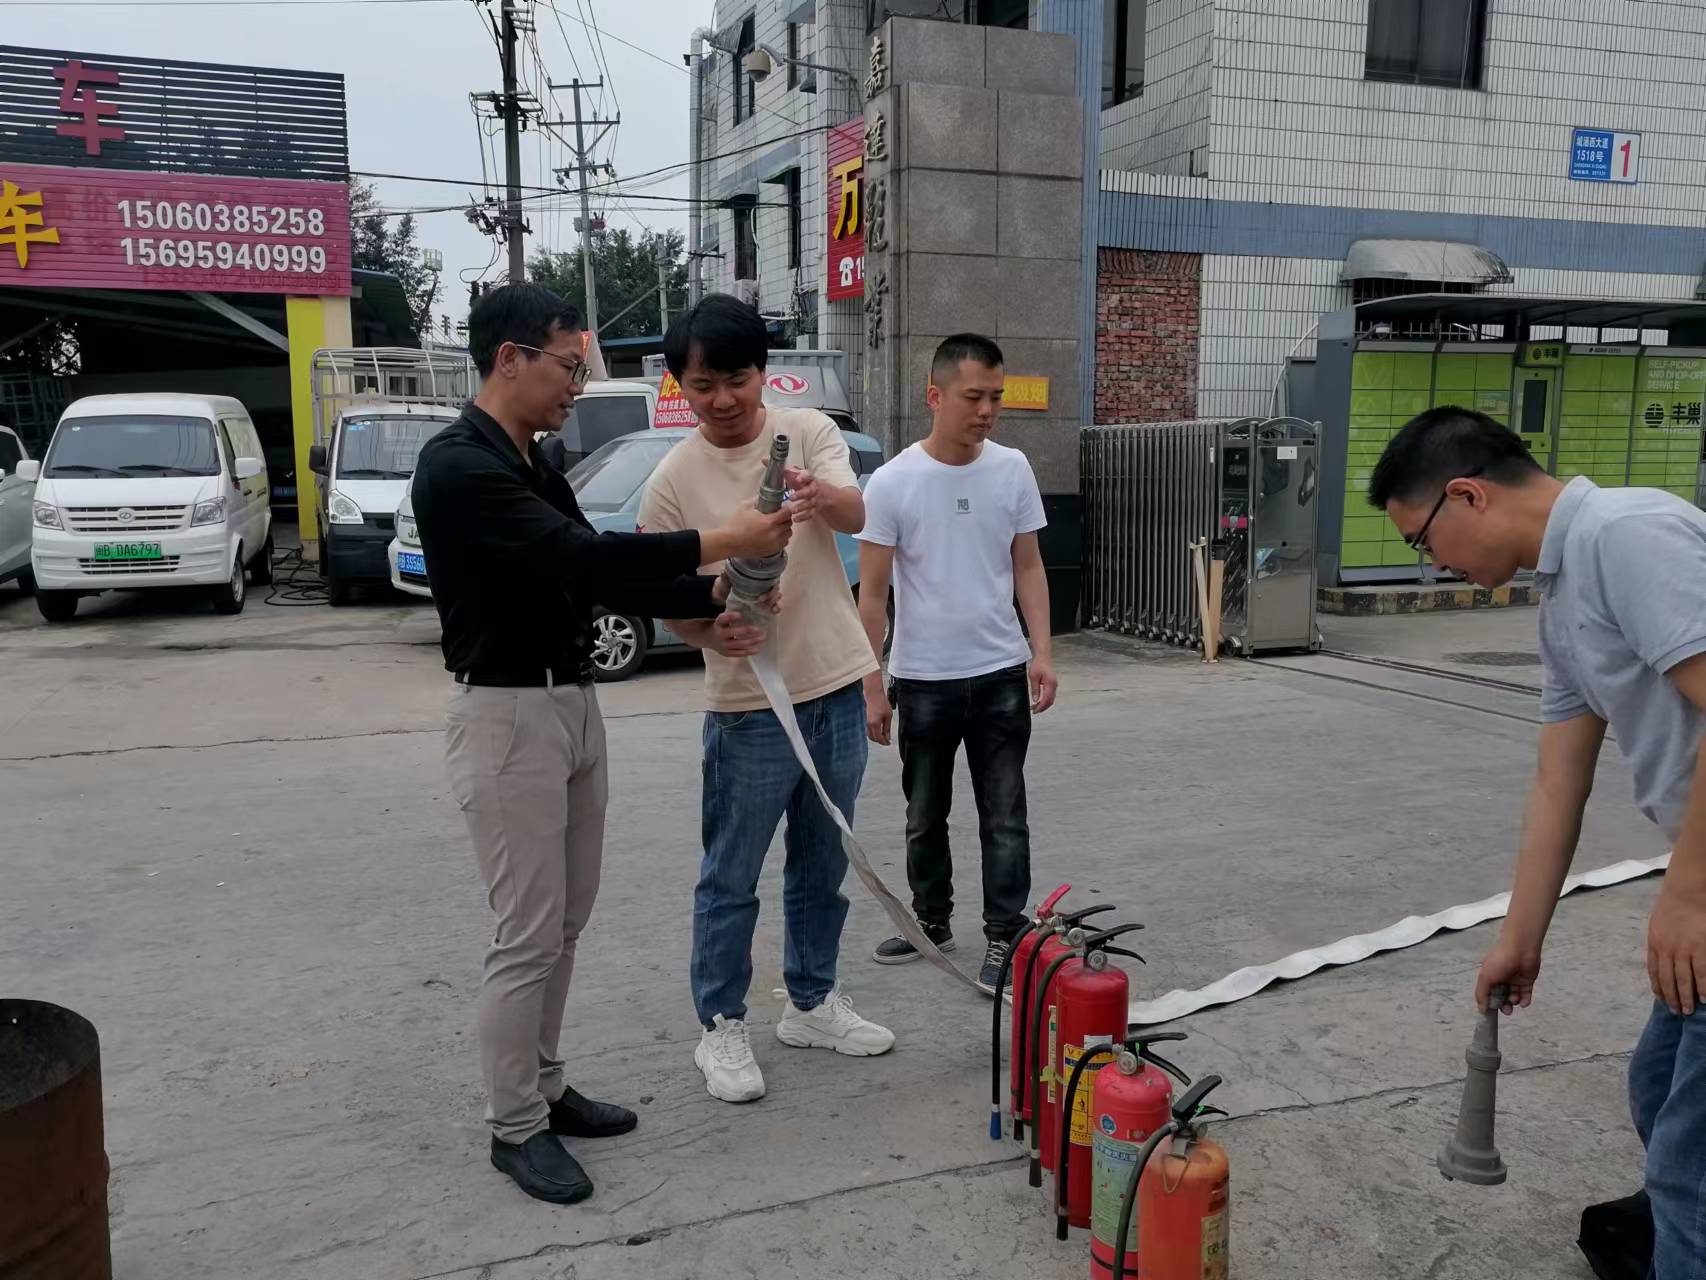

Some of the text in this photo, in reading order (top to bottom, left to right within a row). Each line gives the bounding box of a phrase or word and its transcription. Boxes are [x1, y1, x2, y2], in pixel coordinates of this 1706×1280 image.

[53, 59, 125, 155] 车
[1577, 149, 1604, 162] 1518号
[1620, 140, 1632, 177] 1
[832, 155, 863, 240] 万
[117, 199, 325, 236] 15060385258
[120, 237, 327, 274] 15695940999
[1671, 402, 1701, 425] 丰巢
